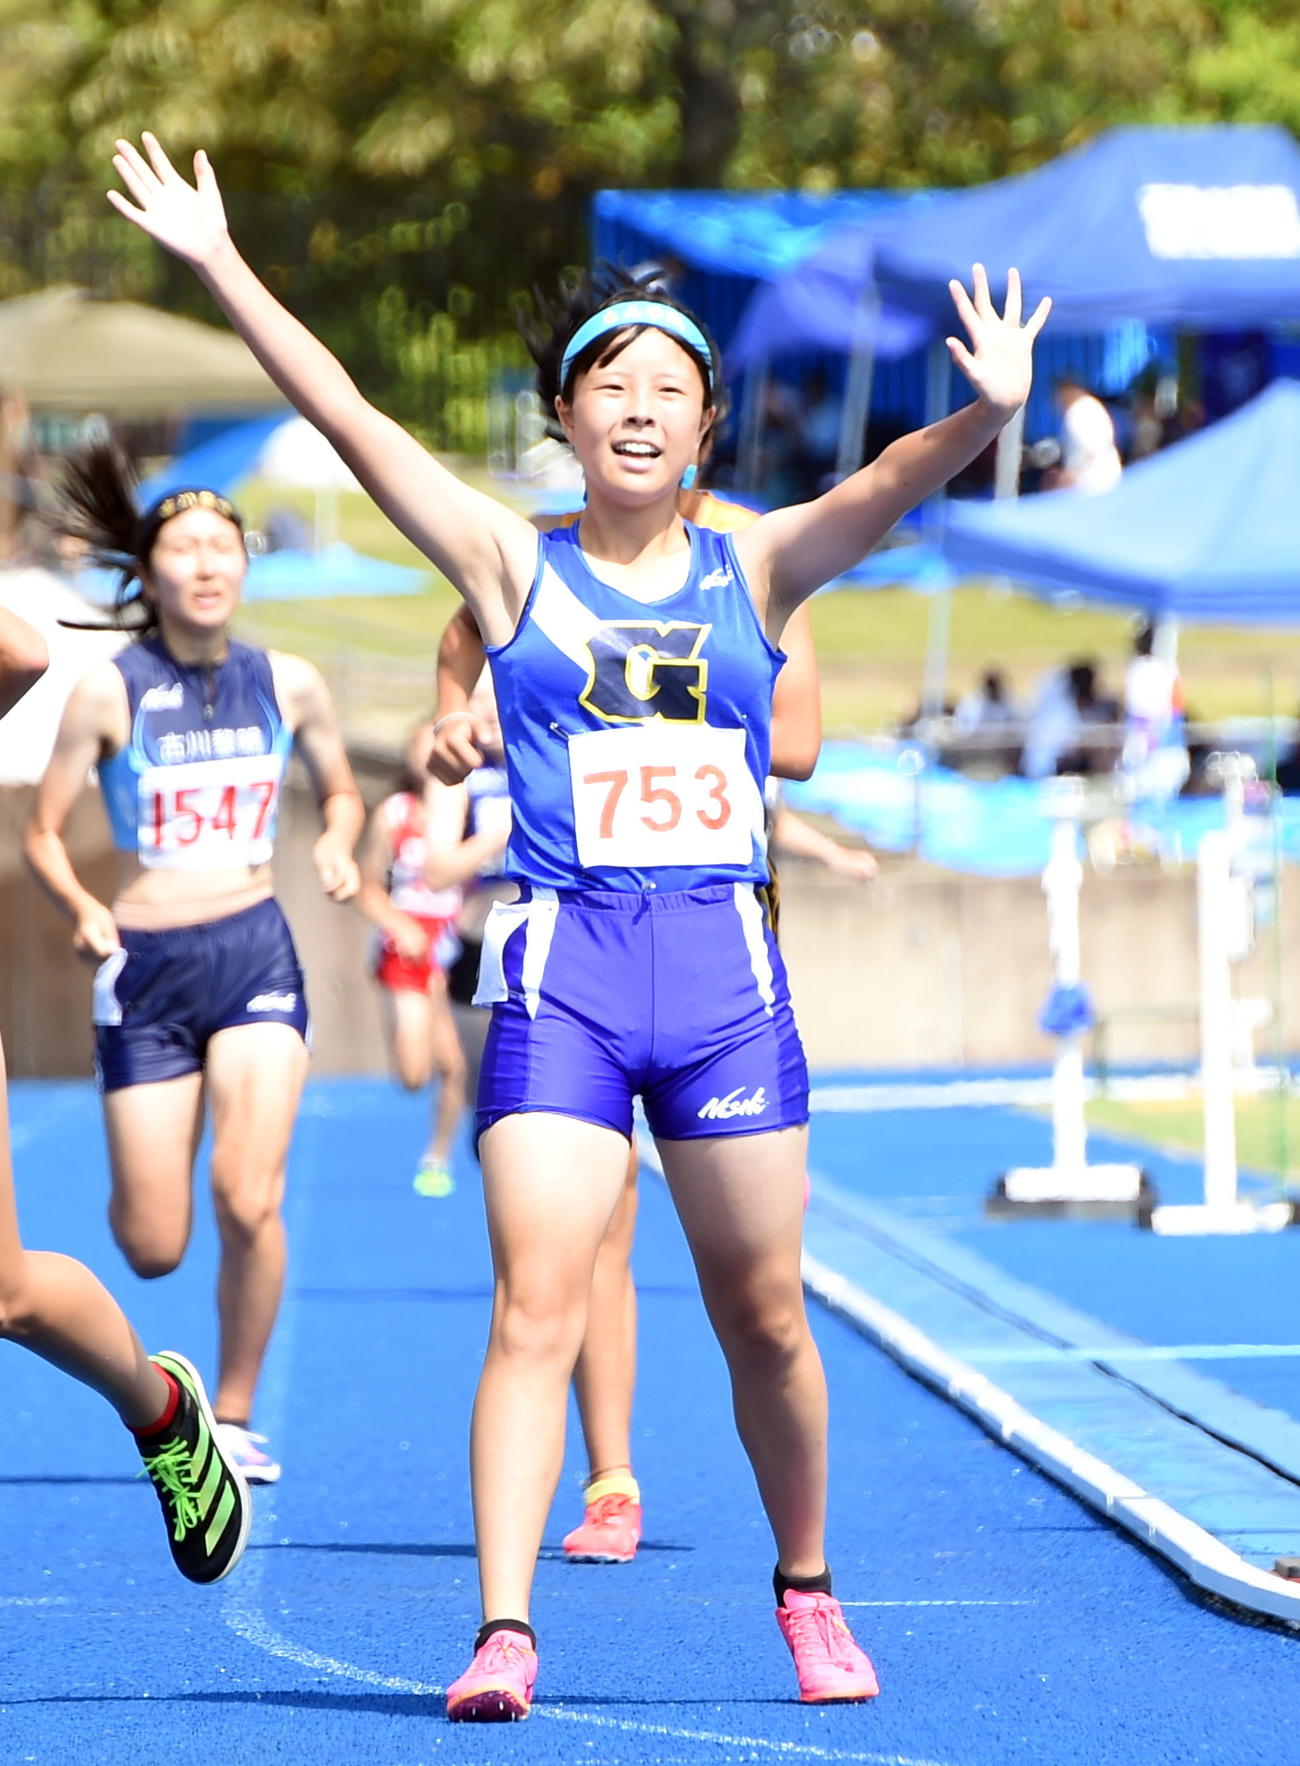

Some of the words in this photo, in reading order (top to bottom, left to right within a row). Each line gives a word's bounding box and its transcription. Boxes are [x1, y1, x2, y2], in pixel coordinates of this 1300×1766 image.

[578, 620, 712, 725] G
[154, 782, 275, 849] 1547
[583, 764, 731, 838] 753
